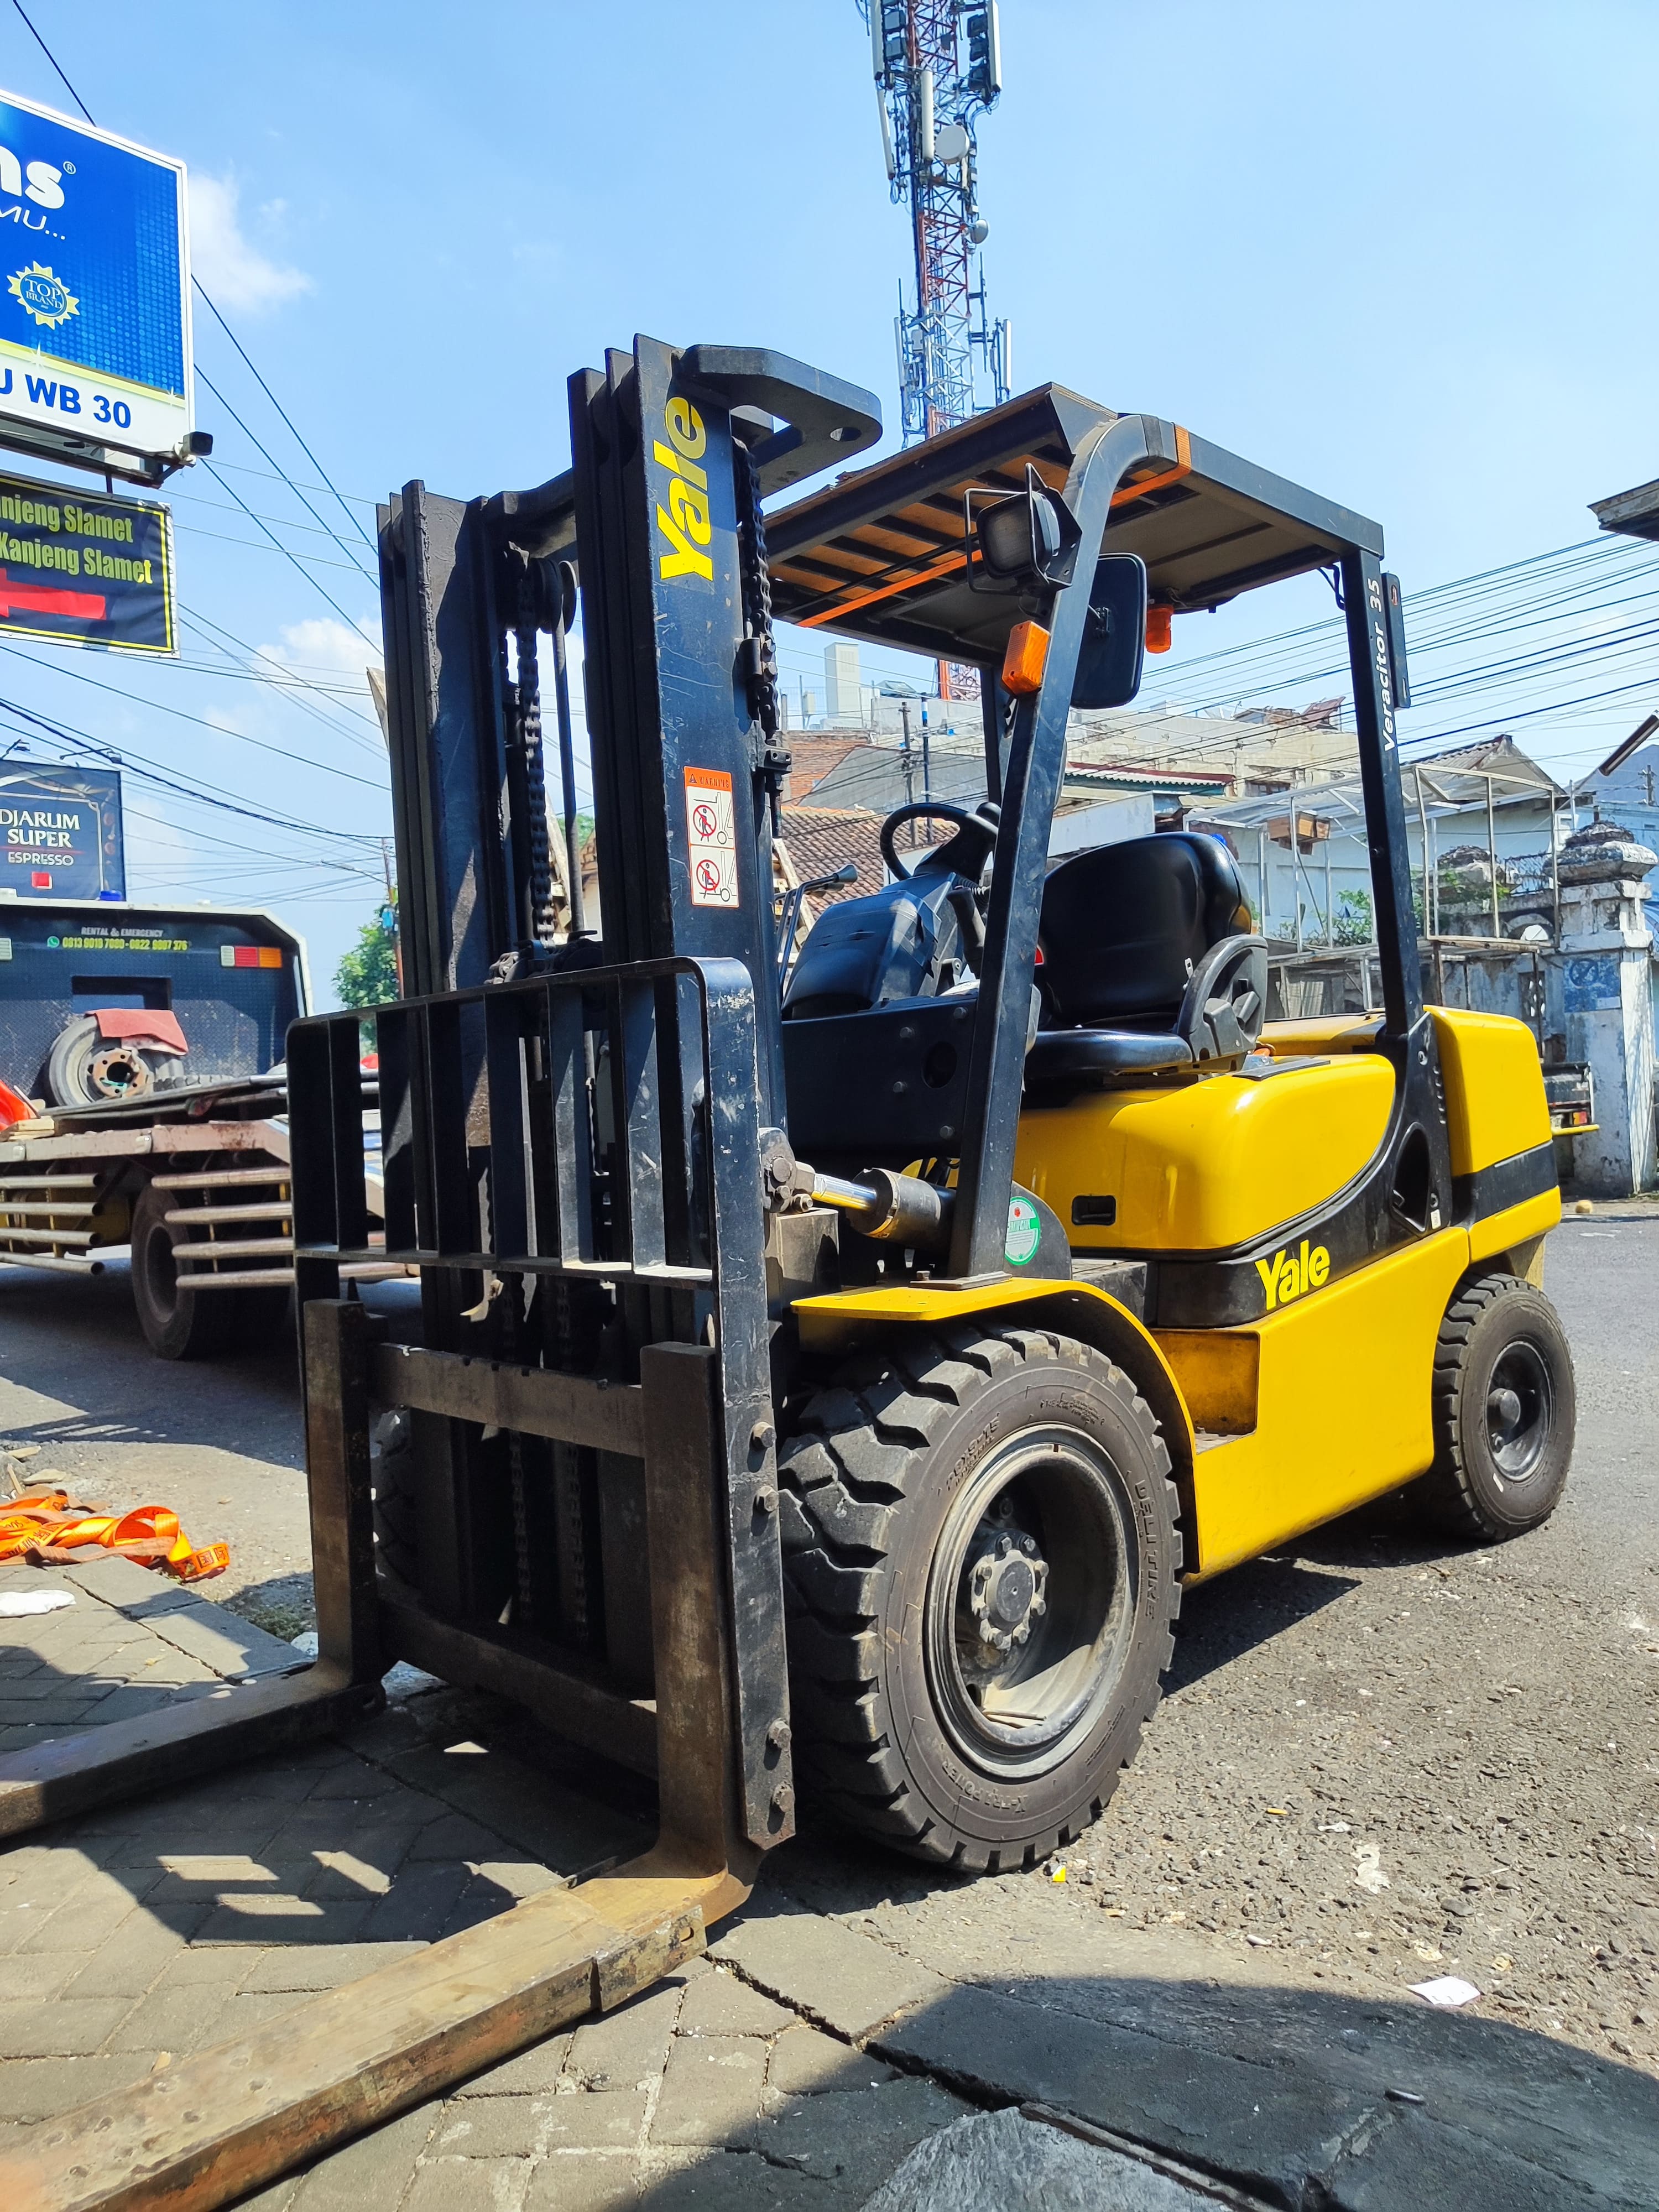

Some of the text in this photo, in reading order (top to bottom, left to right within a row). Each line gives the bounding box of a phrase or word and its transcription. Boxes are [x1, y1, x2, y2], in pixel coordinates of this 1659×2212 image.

[25, 278, 61, 300] TOP
[25, 290, 62, 309] BRAND
[25, 374, 81, 415] WB
[93, 395, 131, 429] 30
[654, 397, 713, 581] Yale
[0, 494, 134, 543] njeng Slamet
[0, 531, 153, 585] Kanjeng Slamet
[1367, 578, 1395, 752] Veracitor 35
[699, 776, 729, 788] WARNING
[0, 808, 80, 830] DJARUM
[8, 828, 73, 848] SUPER
[8, 851, 75, 867] ESPRESSO
[81, 926, 164, 937] RENTAL & EMERGENCY
[1255, 1239, 1331, 1310] Yale
